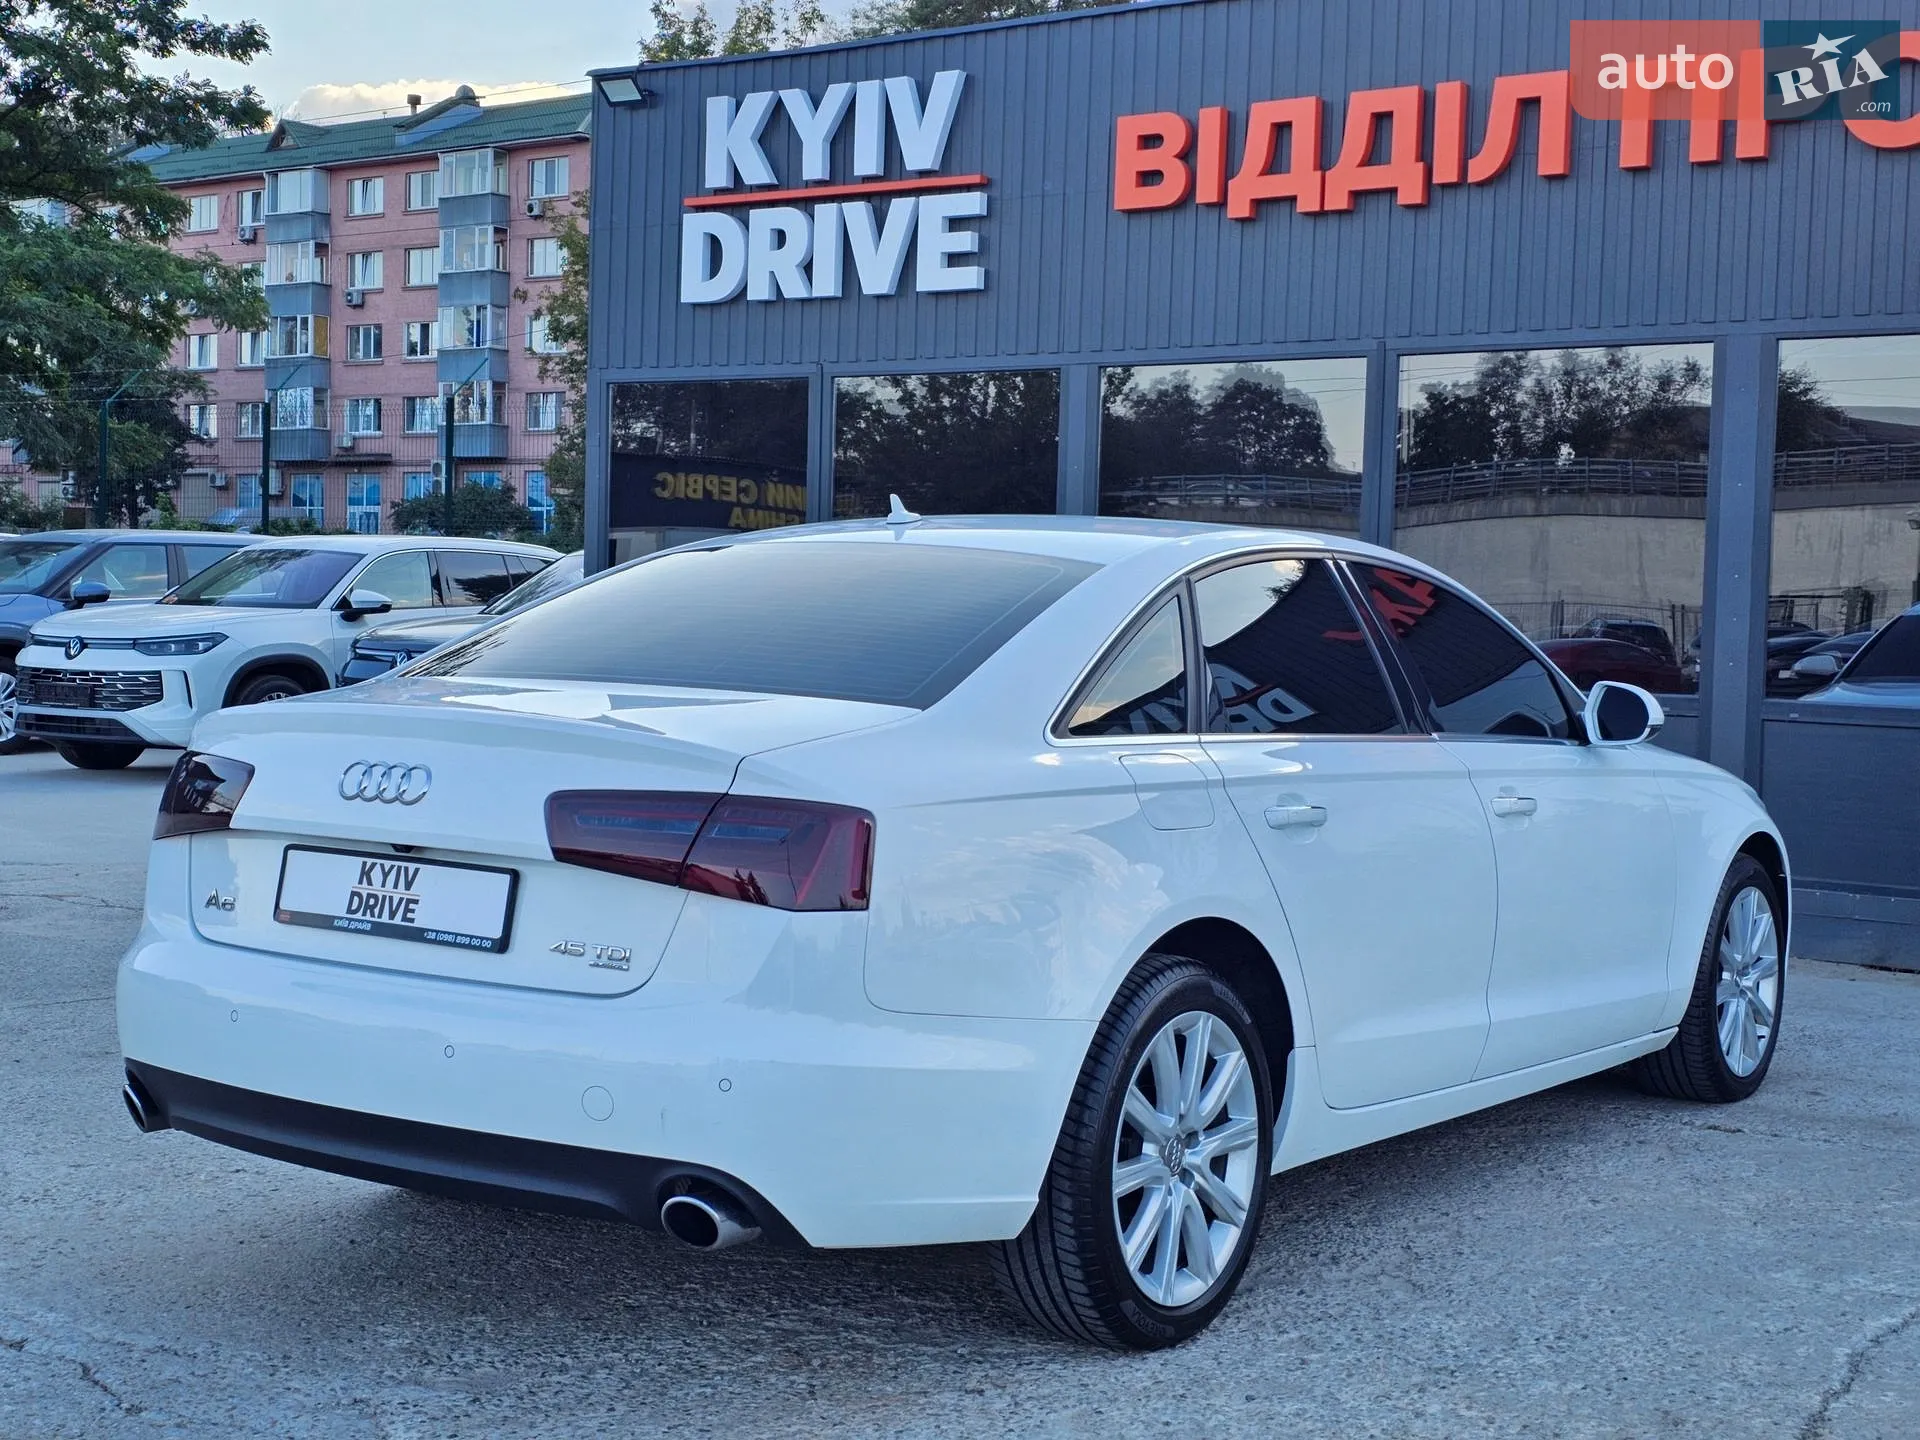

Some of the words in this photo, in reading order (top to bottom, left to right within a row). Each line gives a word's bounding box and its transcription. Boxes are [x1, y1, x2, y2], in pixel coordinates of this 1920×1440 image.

[705, 70, 967, 189] KYIV
[1113, 70, 1571, 220] ВІДДІЛ
[681, 191, 988, 303] DRIVE
[358, 860, 421, 891] KYIV
[204, 888, 236, 911] A6
[346, 890, 420, 924] DRIVE
[423, 931, 435, 940] +38
[437, 932, 455, 943] (098)
[456, 935, 471, 945] 899
[471, 938, 481, 946] 00
[481, 940, 492, 948] 00
[549, 940, 585, 957] 45
[592, 943, 631, 963] TDI
